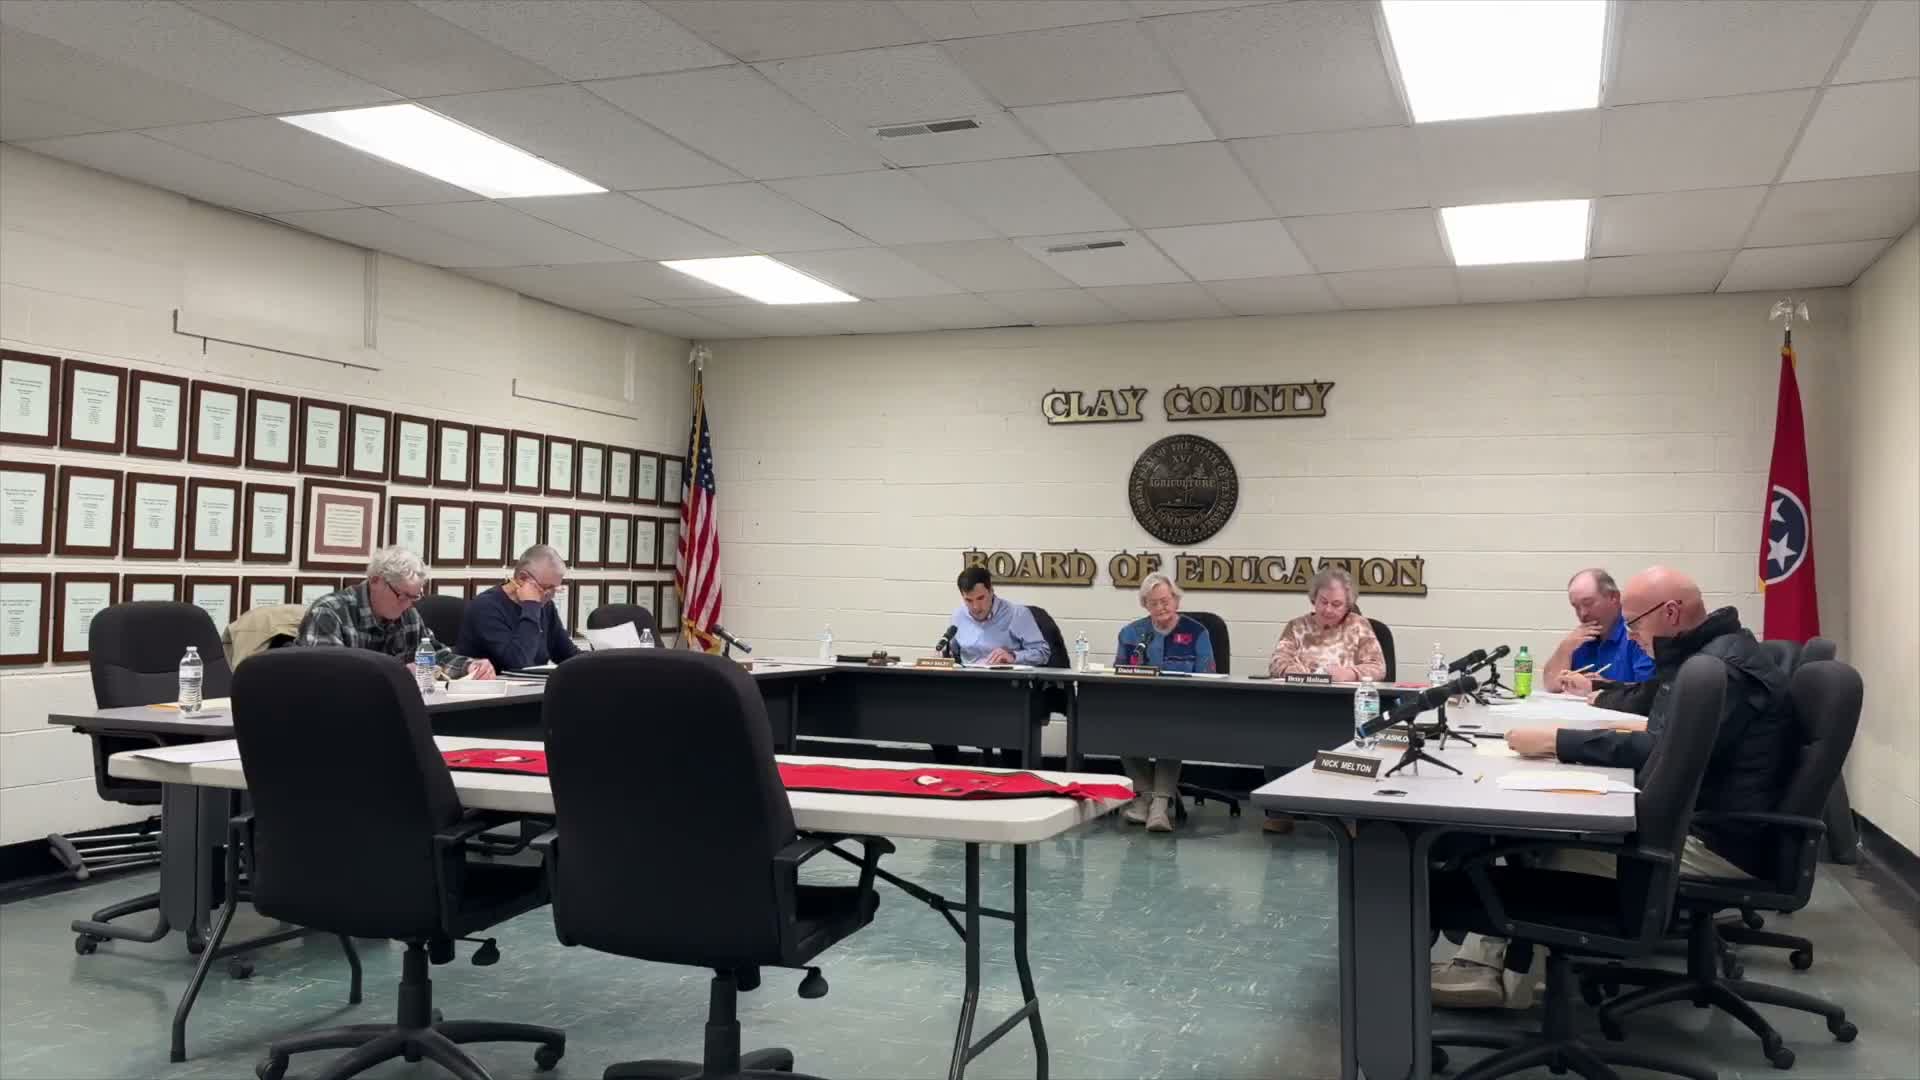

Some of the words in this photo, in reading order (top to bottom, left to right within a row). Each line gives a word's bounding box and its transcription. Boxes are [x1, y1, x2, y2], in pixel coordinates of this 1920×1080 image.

[1041, 388, 1148, 422] CLAY
[1163, 382, 1334, 419] COUNTY
[963, 550, 1096, 585] BOARD
[1321, 759, 1338, 768] NICK
[1340, 761, 1373, 773] MELTON
